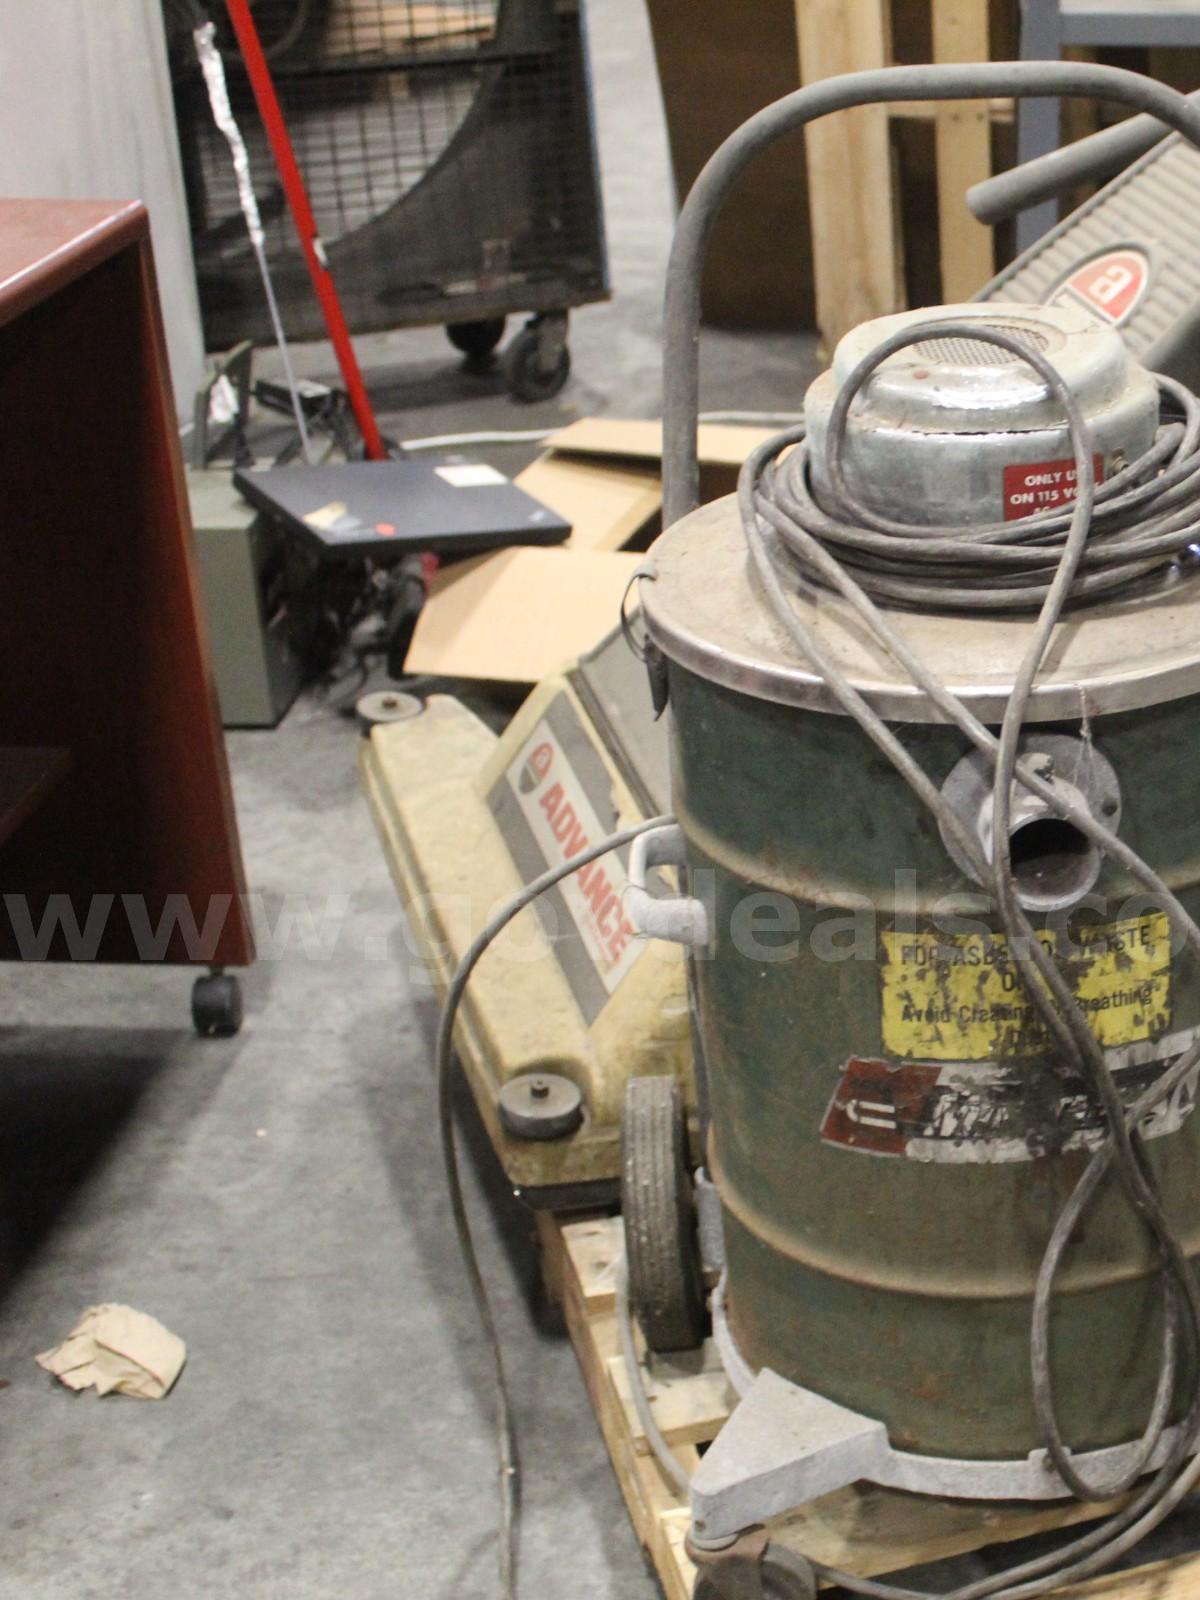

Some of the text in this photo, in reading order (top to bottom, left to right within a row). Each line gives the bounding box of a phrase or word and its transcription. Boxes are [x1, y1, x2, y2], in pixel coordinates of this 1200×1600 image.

[1024, 471, 1062, 486] ONLY
[1010, 492, 1034, 504] ON
[1038, 490, 1059, 502] 115
[539, 782, 634, 964] ADVANCE
